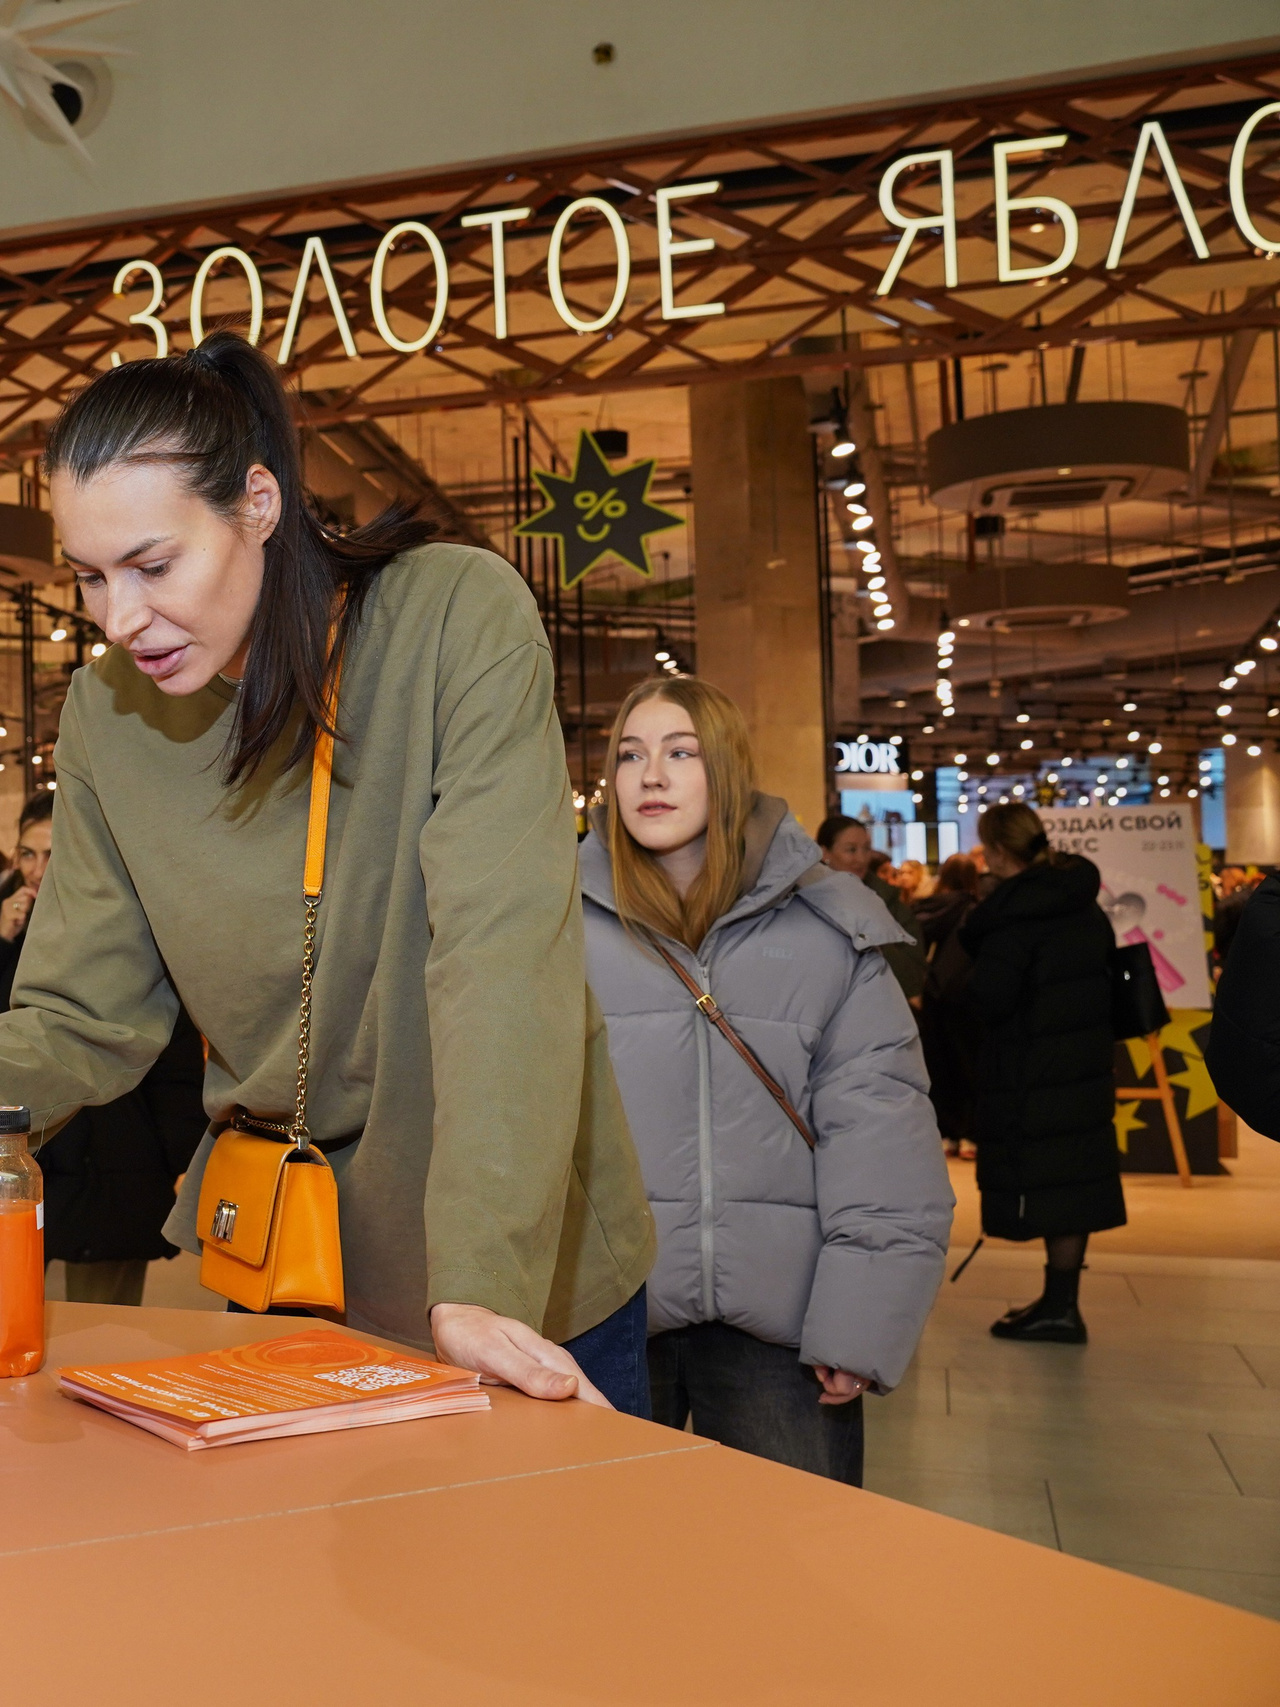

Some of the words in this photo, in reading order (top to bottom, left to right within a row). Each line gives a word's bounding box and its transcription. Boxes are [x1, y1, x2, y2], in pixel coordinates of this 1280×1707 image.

[110, 181, 726, 367] ЗОЛОТОЕ
[833, 742, 901, 774] DIOR
[1042, 813, 1115, 833] ОЗДАЙ
[1119, 810, 1182, 831] СВОЙ
